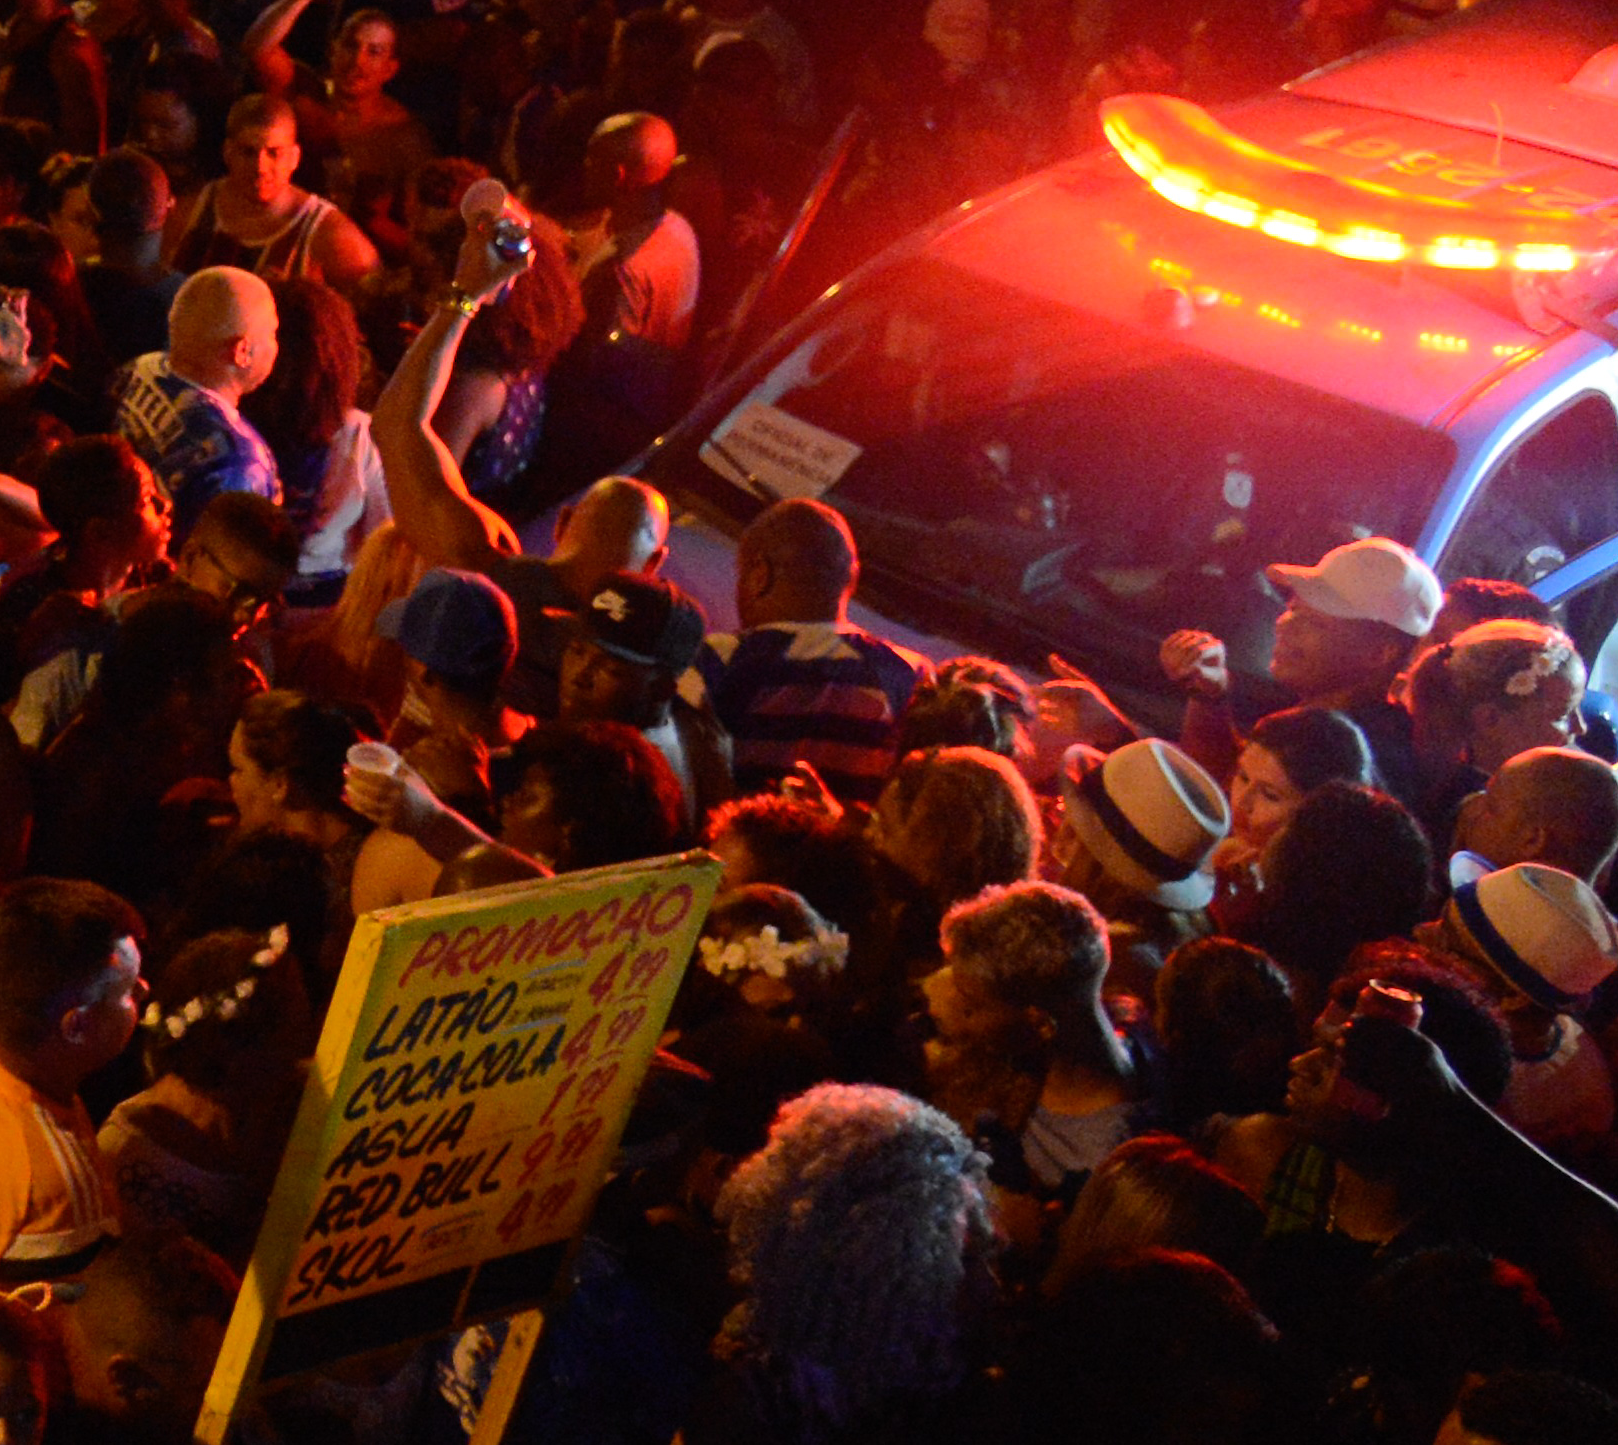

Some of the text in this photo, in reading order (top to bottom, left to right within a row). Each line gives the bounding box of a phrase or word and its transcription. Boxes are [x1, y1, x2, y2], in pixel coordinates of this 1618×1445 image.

[365, 976, 518, 1063] LATÃO
[305, 1172, 402, 1242] RED
[398, 1140, 514, 1219] BULL
[288, 1225, 415, 1306] SKOL
